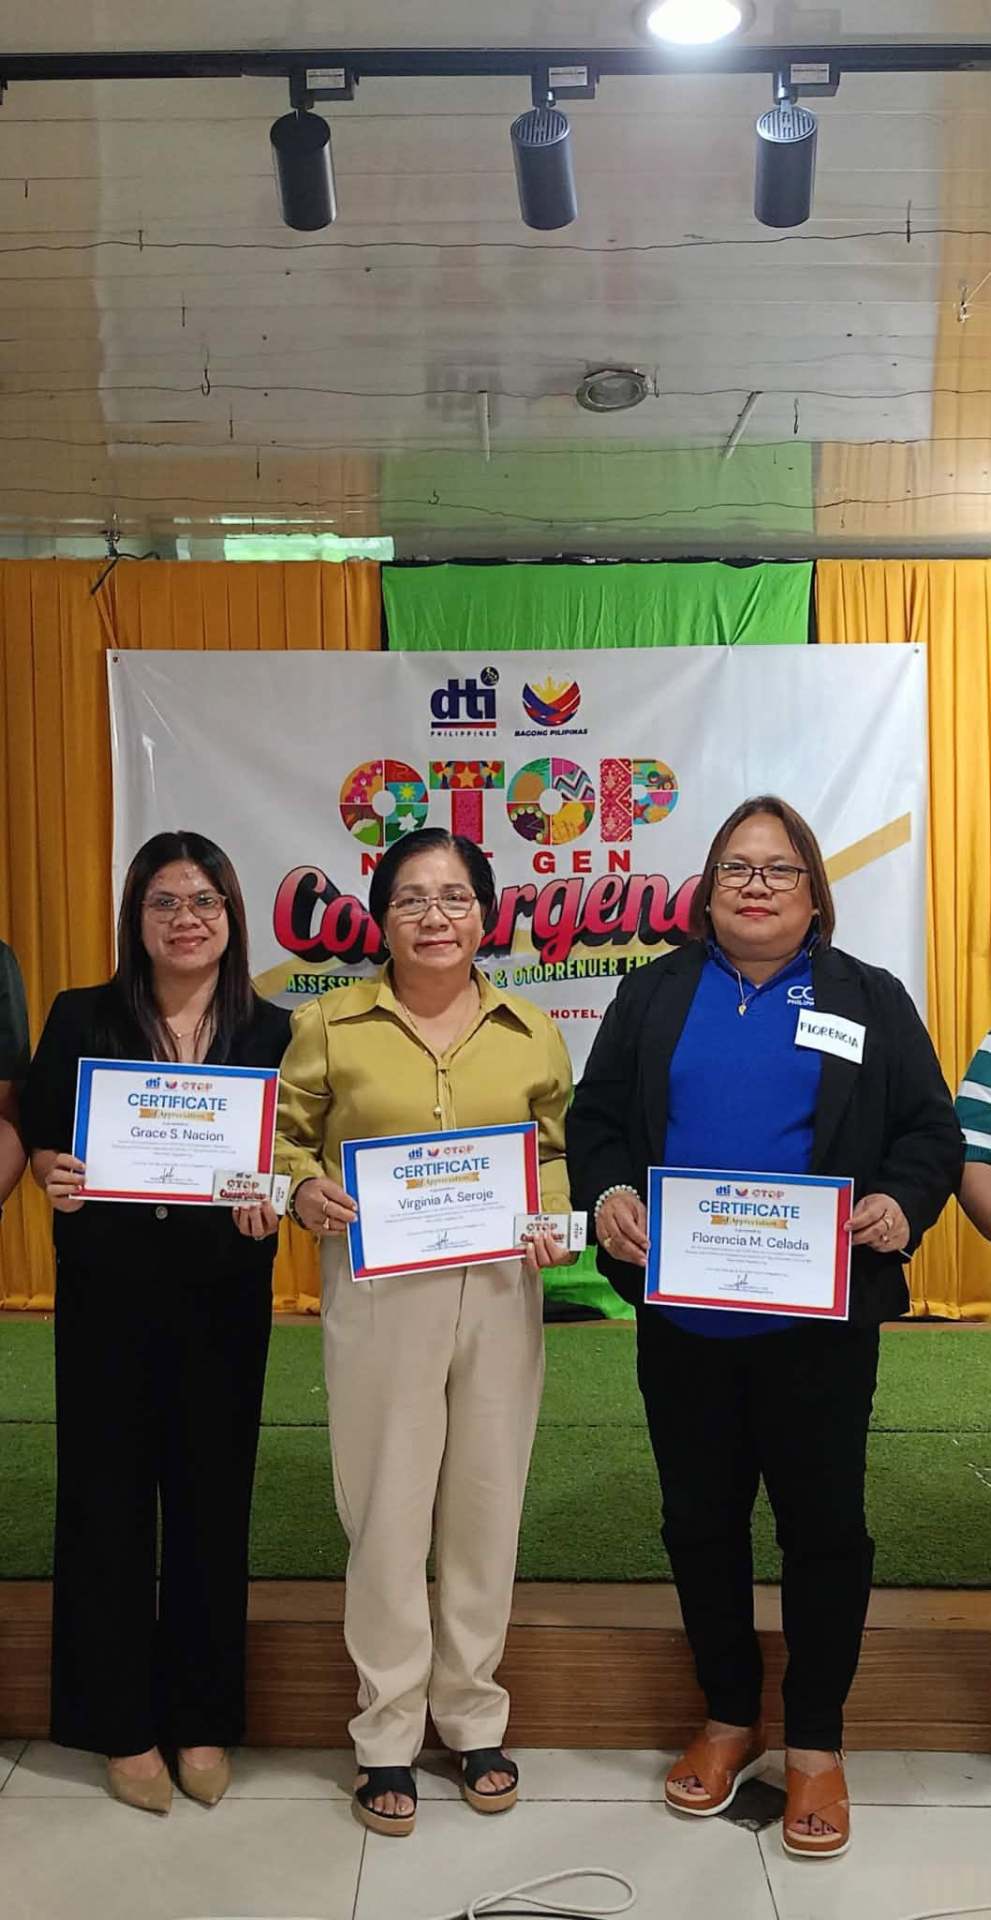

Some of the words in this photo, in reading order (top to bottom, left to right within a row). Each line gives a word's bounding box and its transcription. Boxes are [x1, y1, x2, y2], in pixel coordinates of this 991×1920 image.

[430, 666, 499, 720] dti
[339, 757, 681, 847] OTOP
[532, 850, 631, 874] GEN
[513, 957, 619, 987] OTOPRENUER
[800, 1021, 859, 1048] FLORENCIA
[127, 1093, 228, 1112] CERTIFICATE
[130, 1126, 168, 1140] Grace
[183, 1129, 225, 1142] Nacion
[392, 1156, 490, 1180] CERTIFICATE
[398, 1195, 441, 1211] Virginia
[457, 1189, 494, 1203] Seroje
[698, 1199, 801, 1219] CERTIFICATE
[691, 1231, 747, 1247] Florencia
[766, 1237, 811, 1251] Celada
